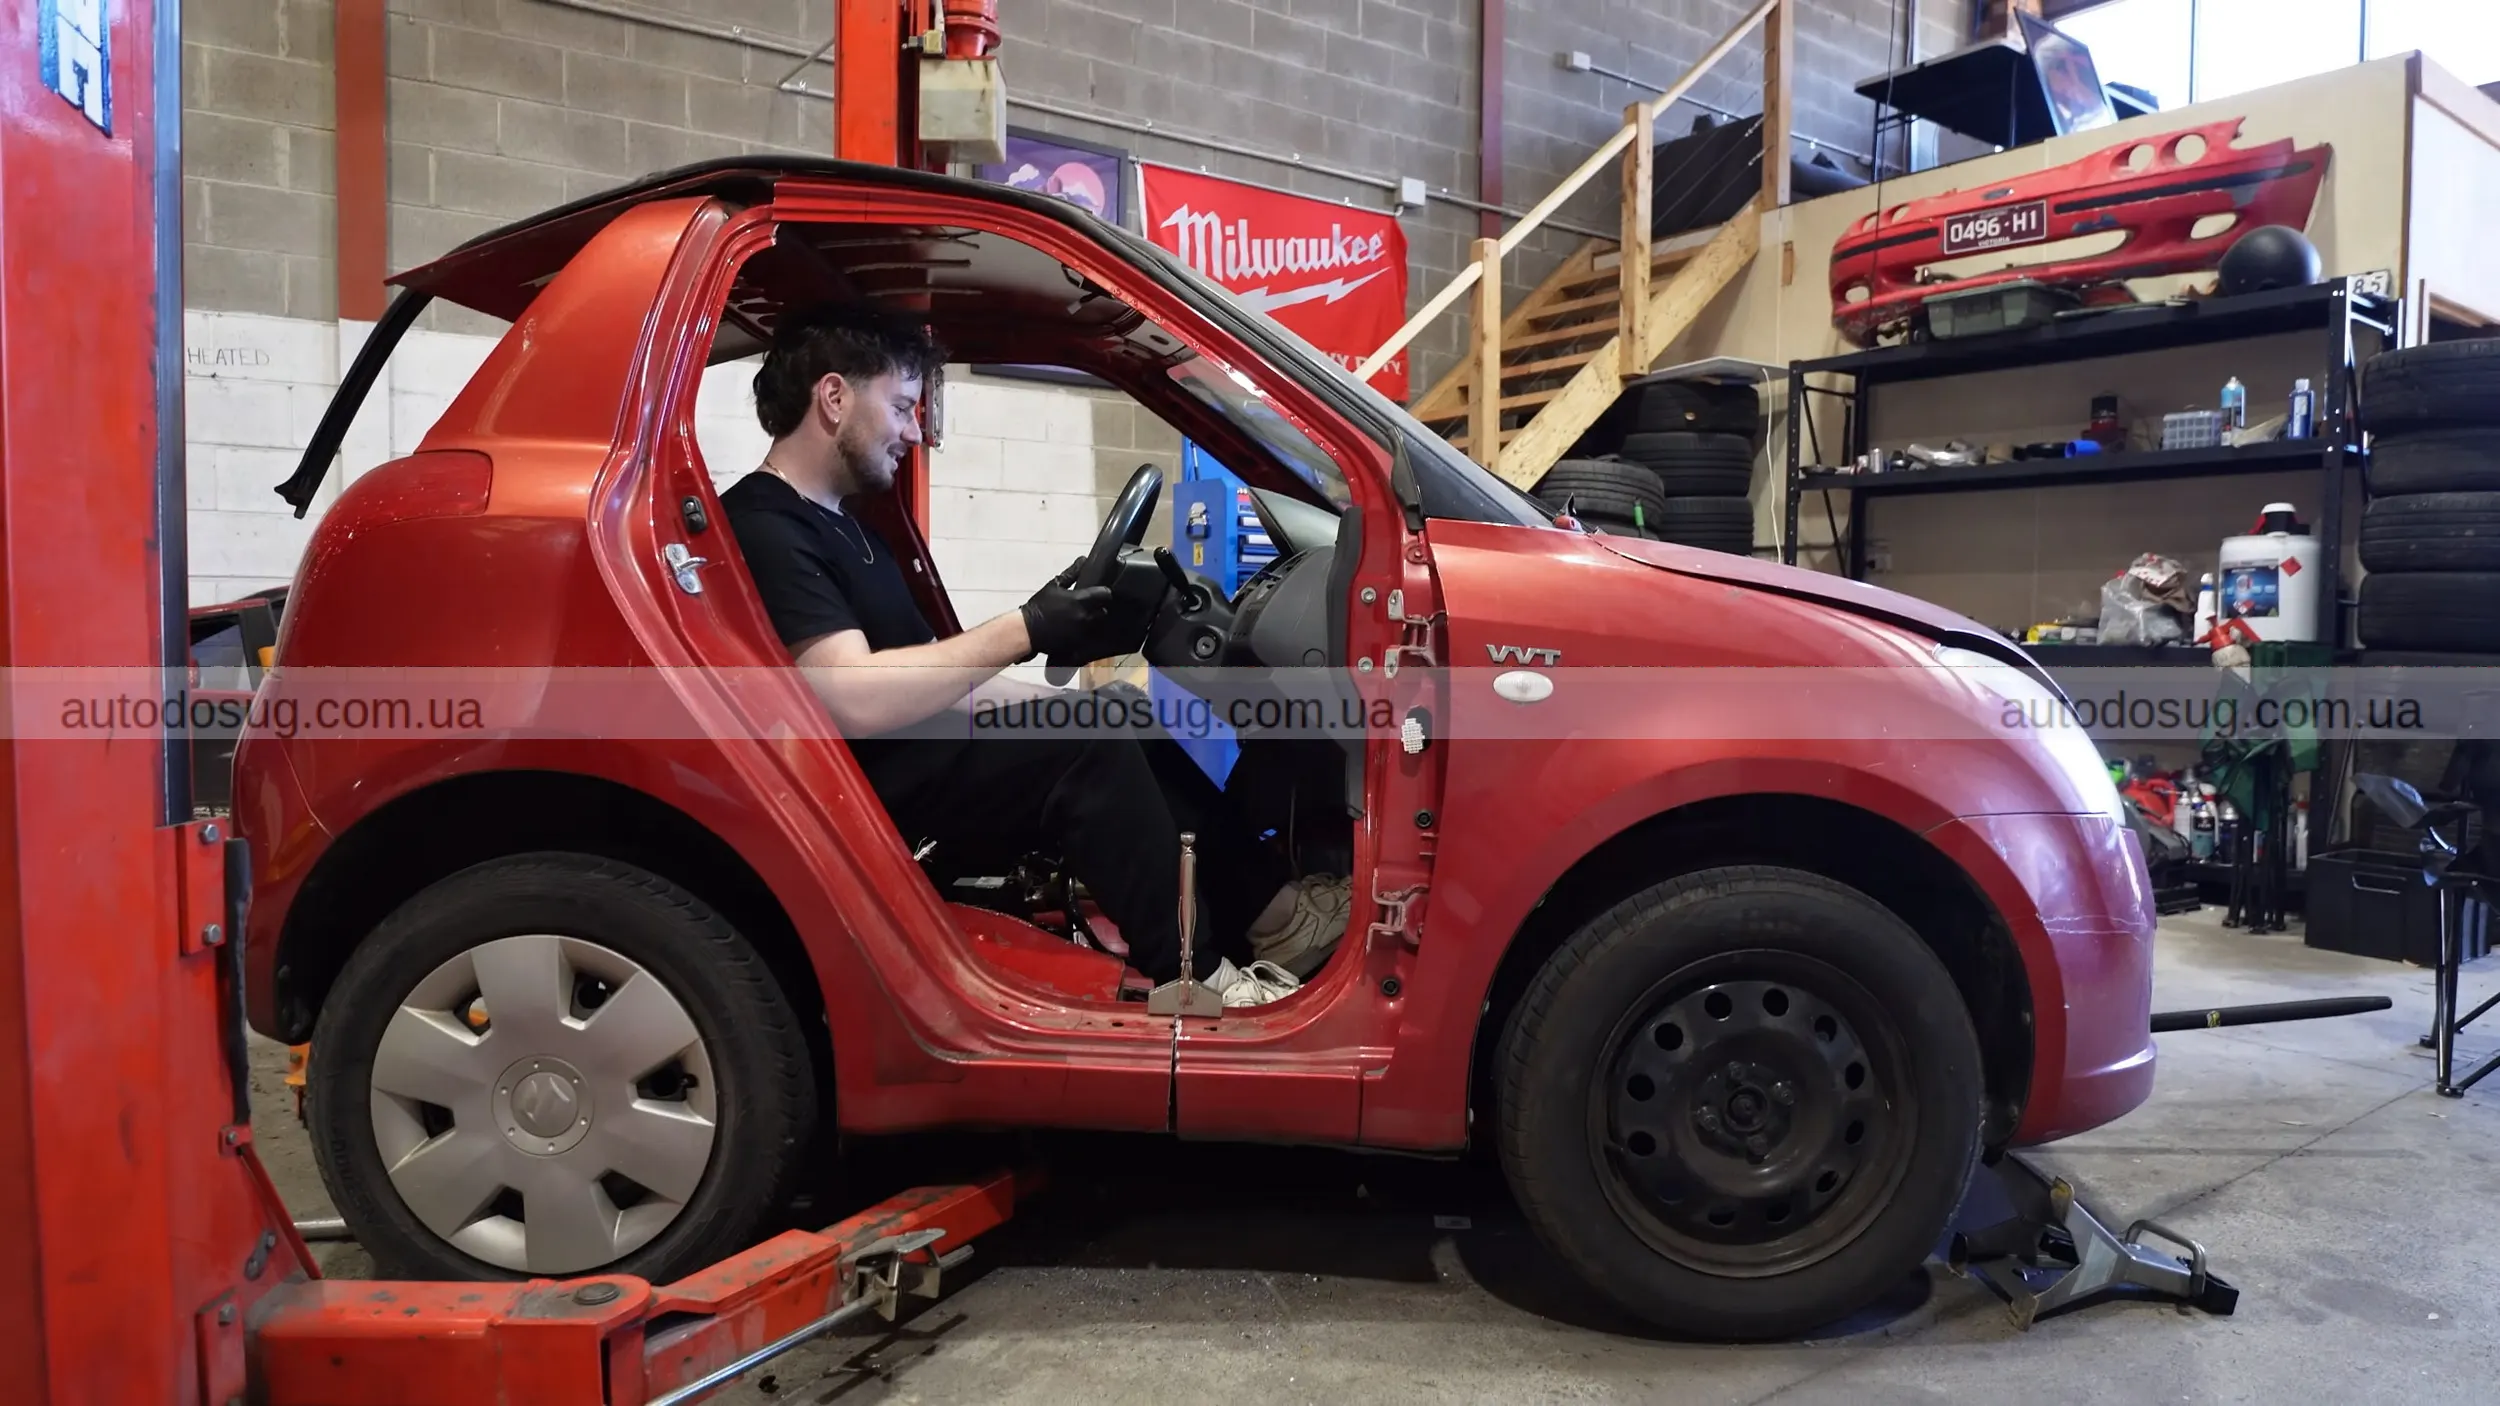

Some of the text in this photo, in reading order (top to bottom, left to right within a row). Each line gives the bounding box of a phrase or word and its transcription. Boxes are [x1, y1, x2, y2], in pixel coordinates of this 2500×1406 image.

[1160, 203, 1384, 282] Milwaukee
[187, 347, 270, 366] HEATED
[1485, 643, 1561, 666] VVT
